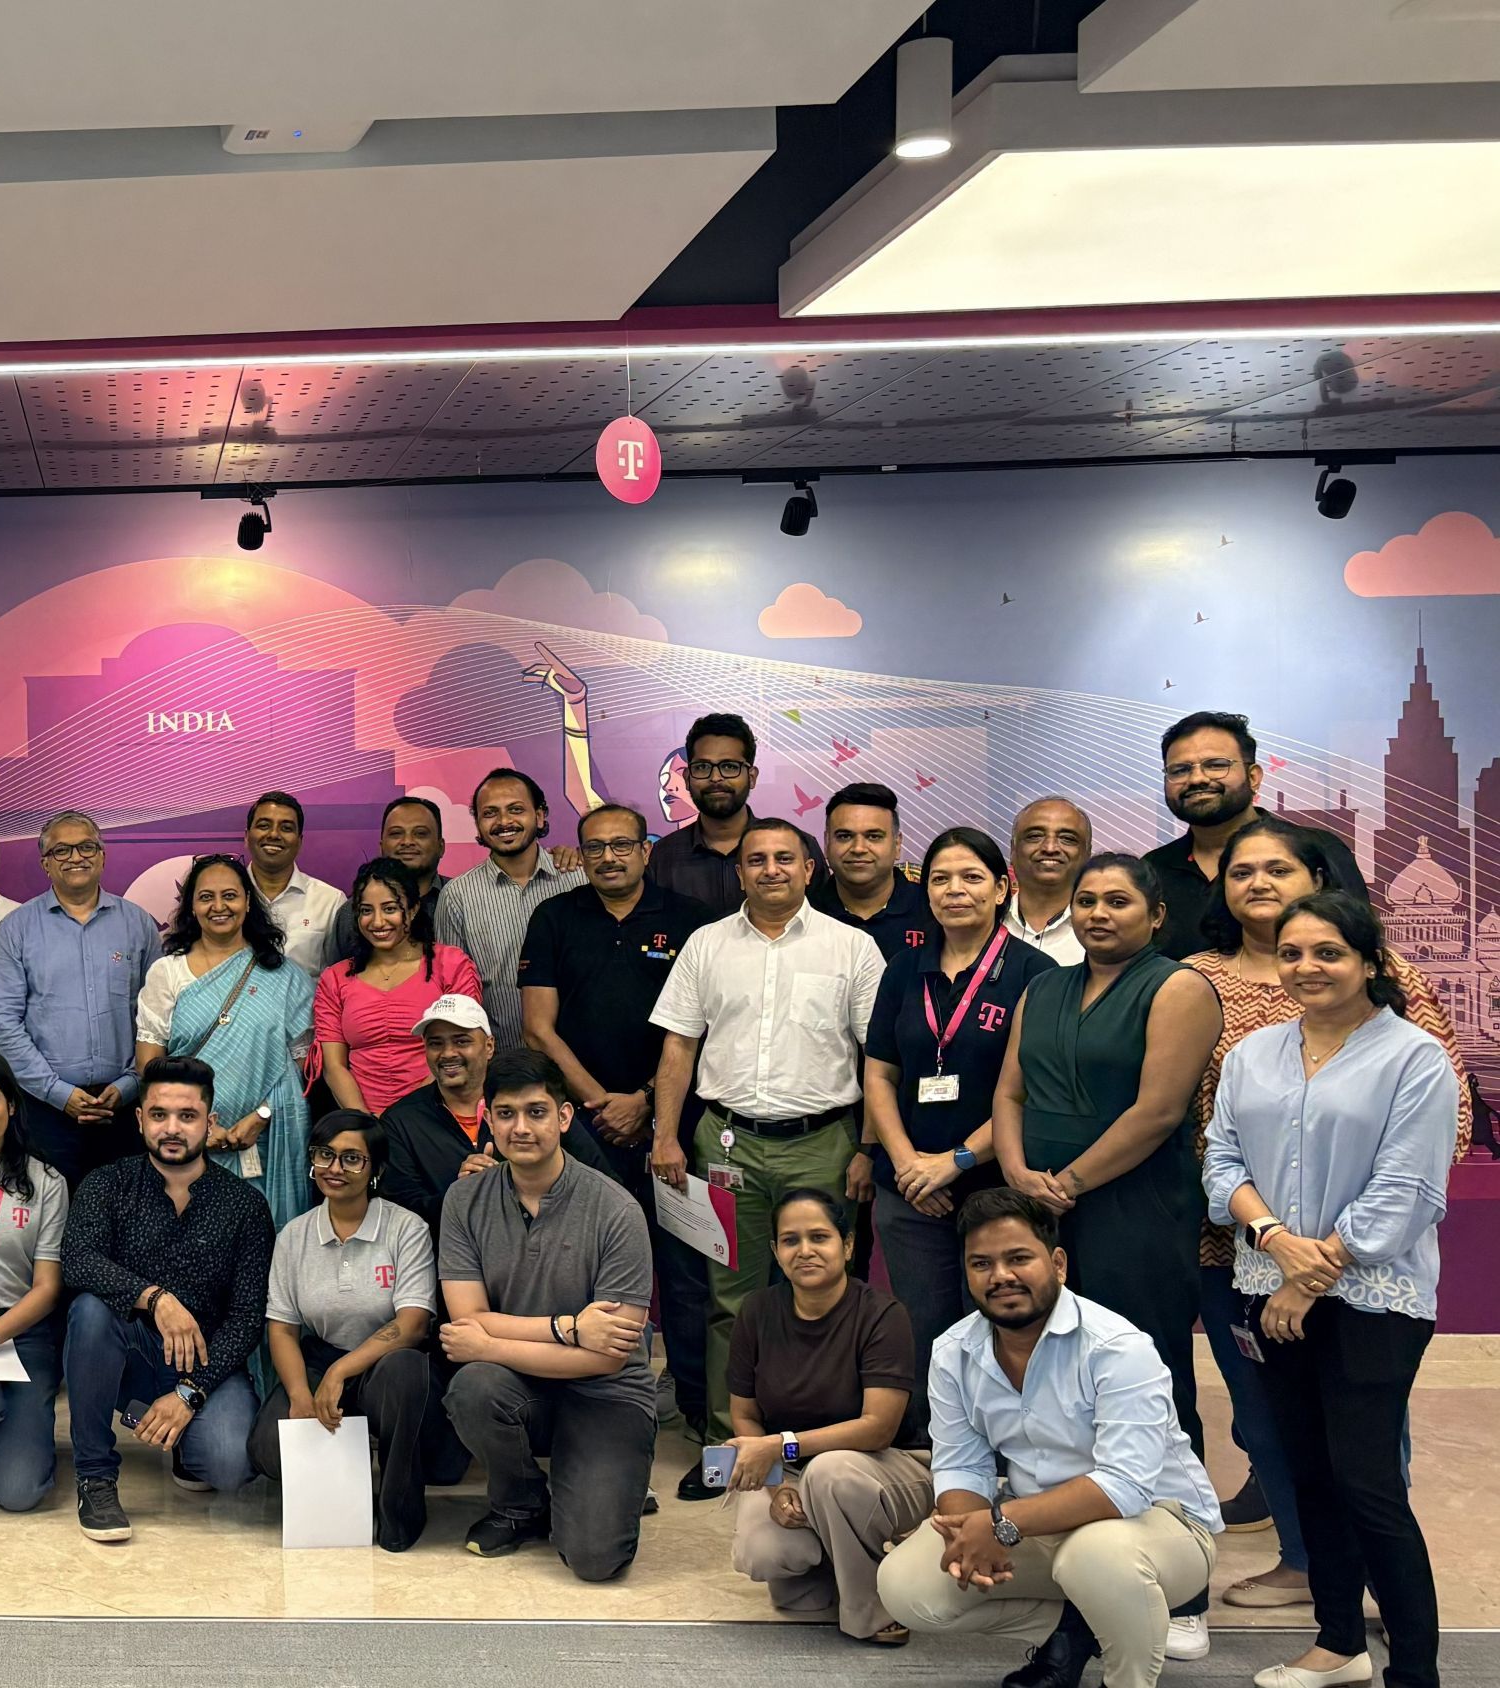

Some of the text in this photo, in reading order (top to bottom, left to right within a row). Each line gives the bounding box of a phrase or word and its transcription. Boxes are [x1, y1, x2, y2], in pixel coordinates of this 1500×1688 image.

[617, 440, 644, 480] T
[148, 710, 235, 733] INDIA
[654, 934, 667, 949] T
[978, 1002, 1006, 1032] T
[13, 1207, 30, 1228] T
[374, 1264, 395, 1288] T
